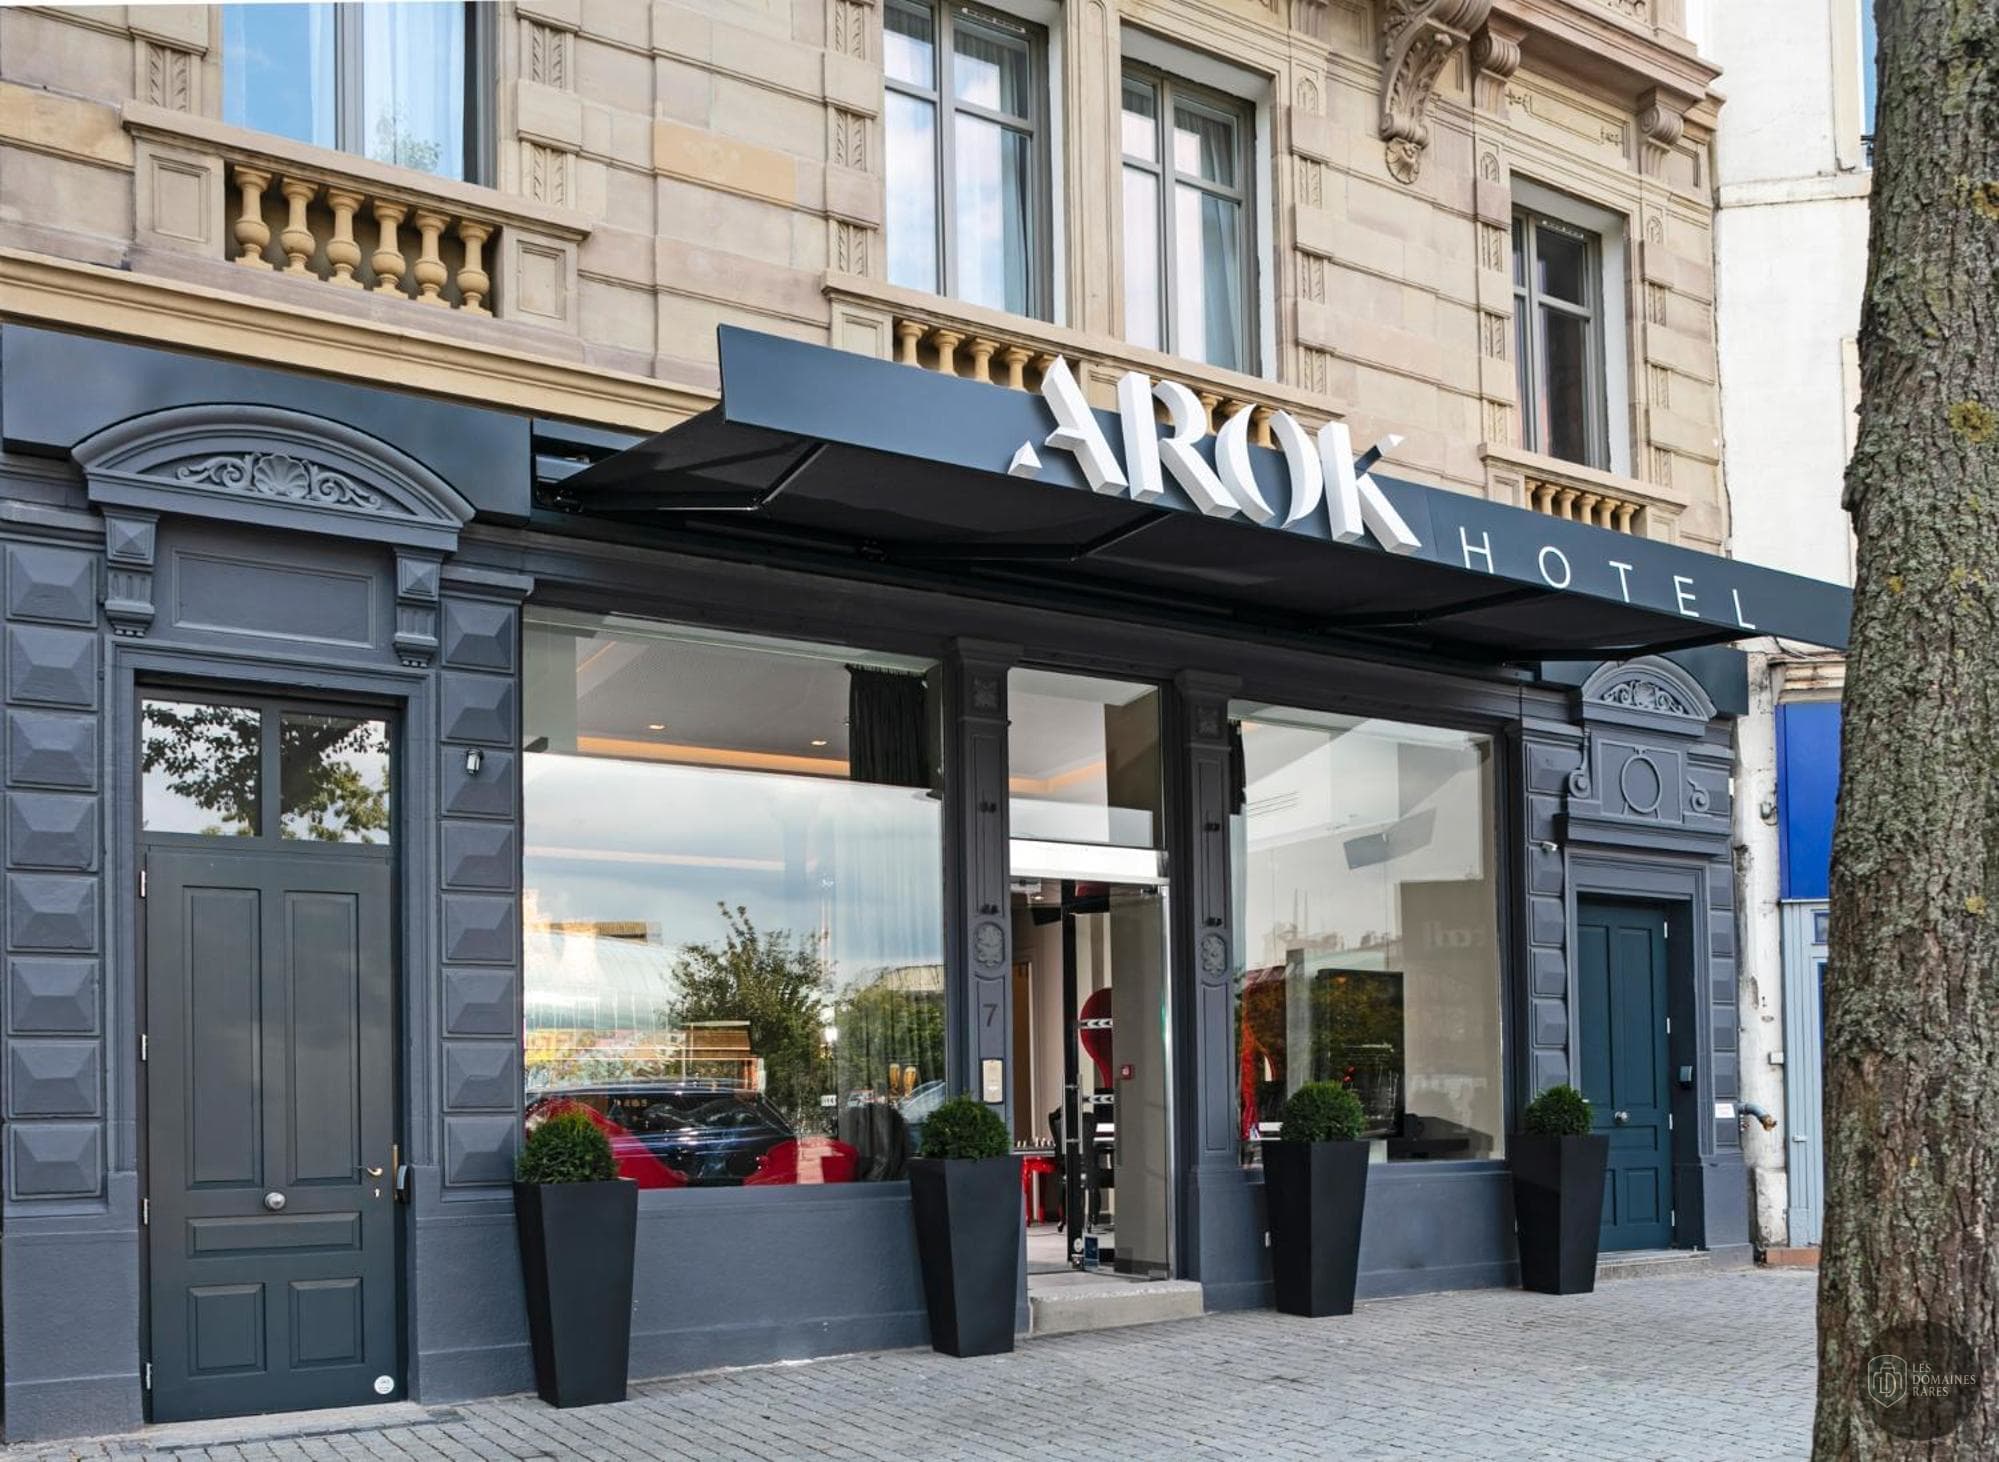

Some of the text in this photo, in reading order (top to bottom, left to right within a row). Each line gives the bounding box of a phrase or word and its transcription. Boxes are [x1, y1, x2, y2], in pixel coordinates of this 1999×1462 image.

[1008, 354, 1756, 630] AROK HOTEL
[982, 1003, 999, 1028] 7
